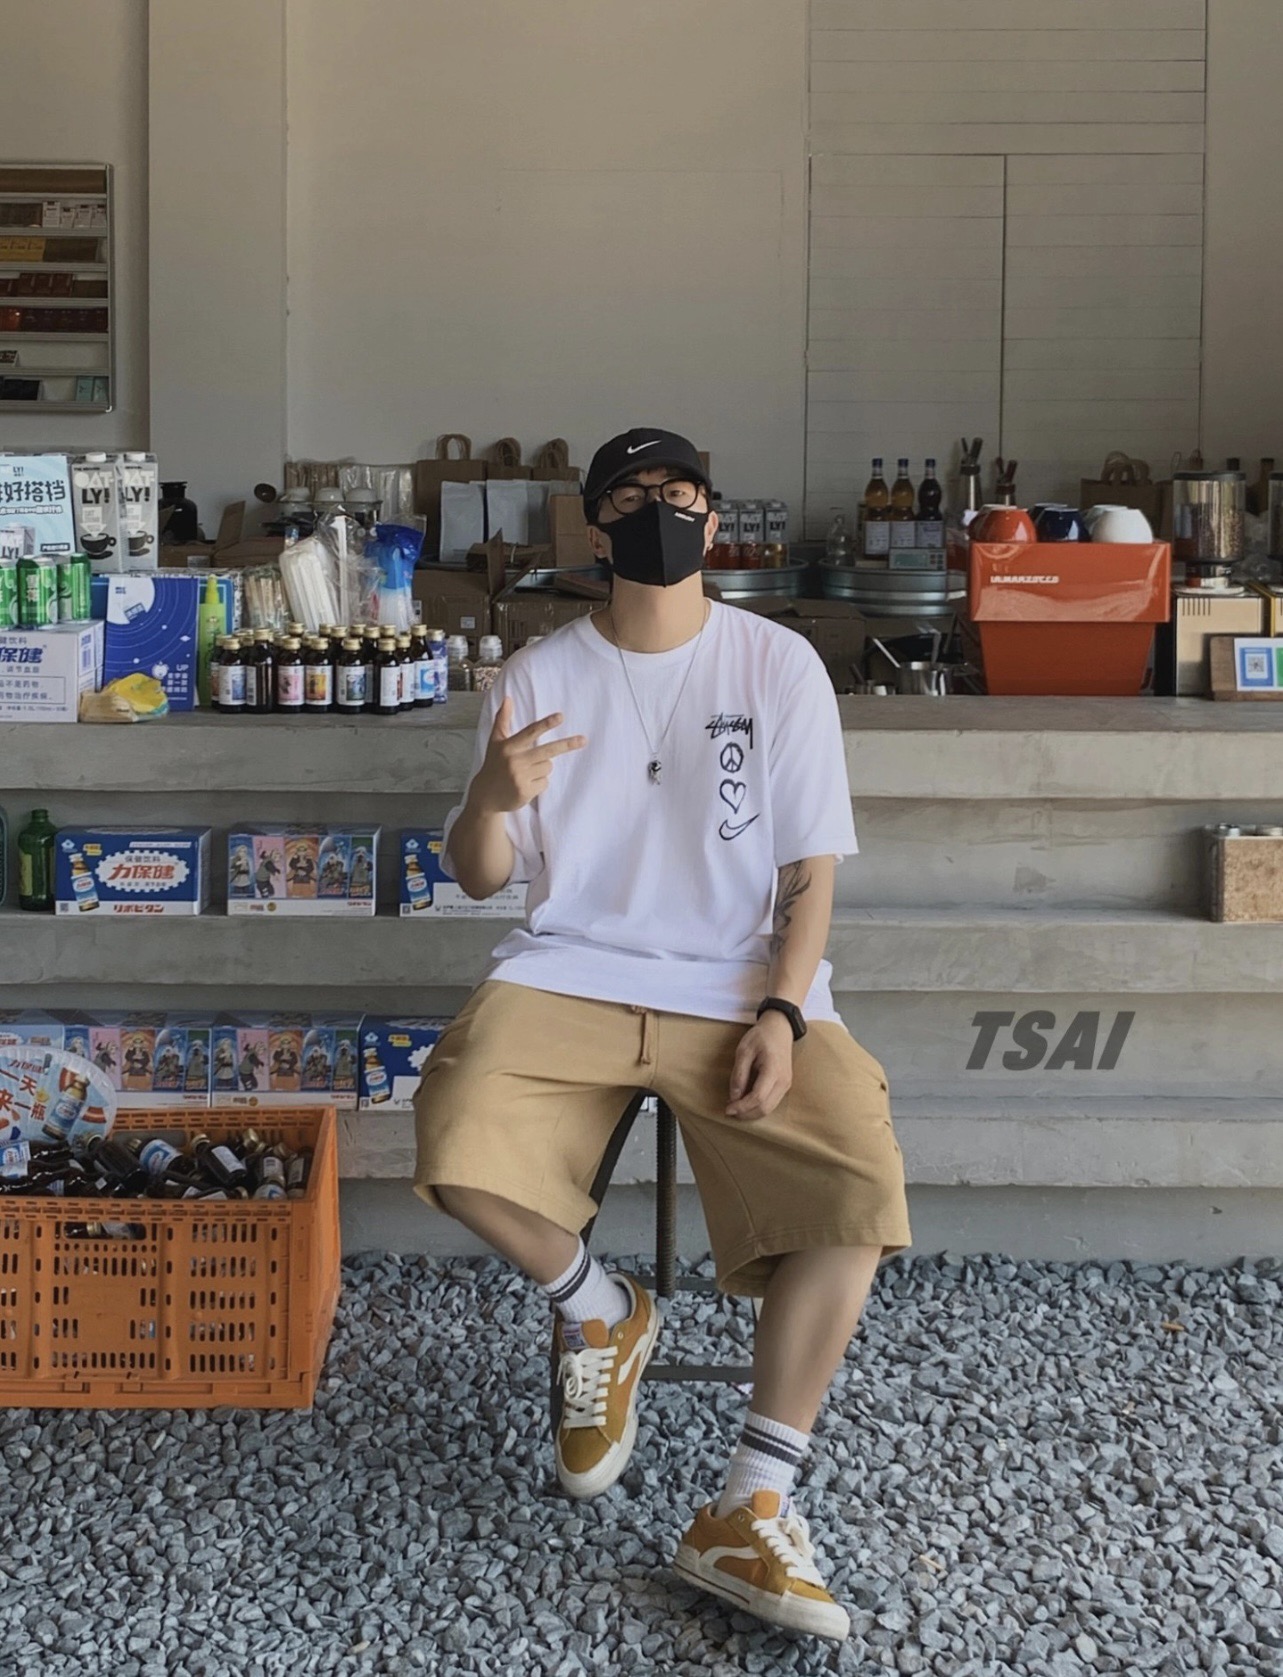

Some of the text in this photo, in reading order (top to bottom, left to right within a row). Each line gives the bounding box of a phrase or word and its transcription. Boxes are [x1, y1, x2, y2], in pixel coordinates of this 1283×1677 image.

[82, 488, 111, 504] LY!
[125, 486, 150, 502] LY!
[743, 523, 760, 532] LY!
[769, 521, 786, 530] LY!
[107, 864, 175, 880] 力保健
